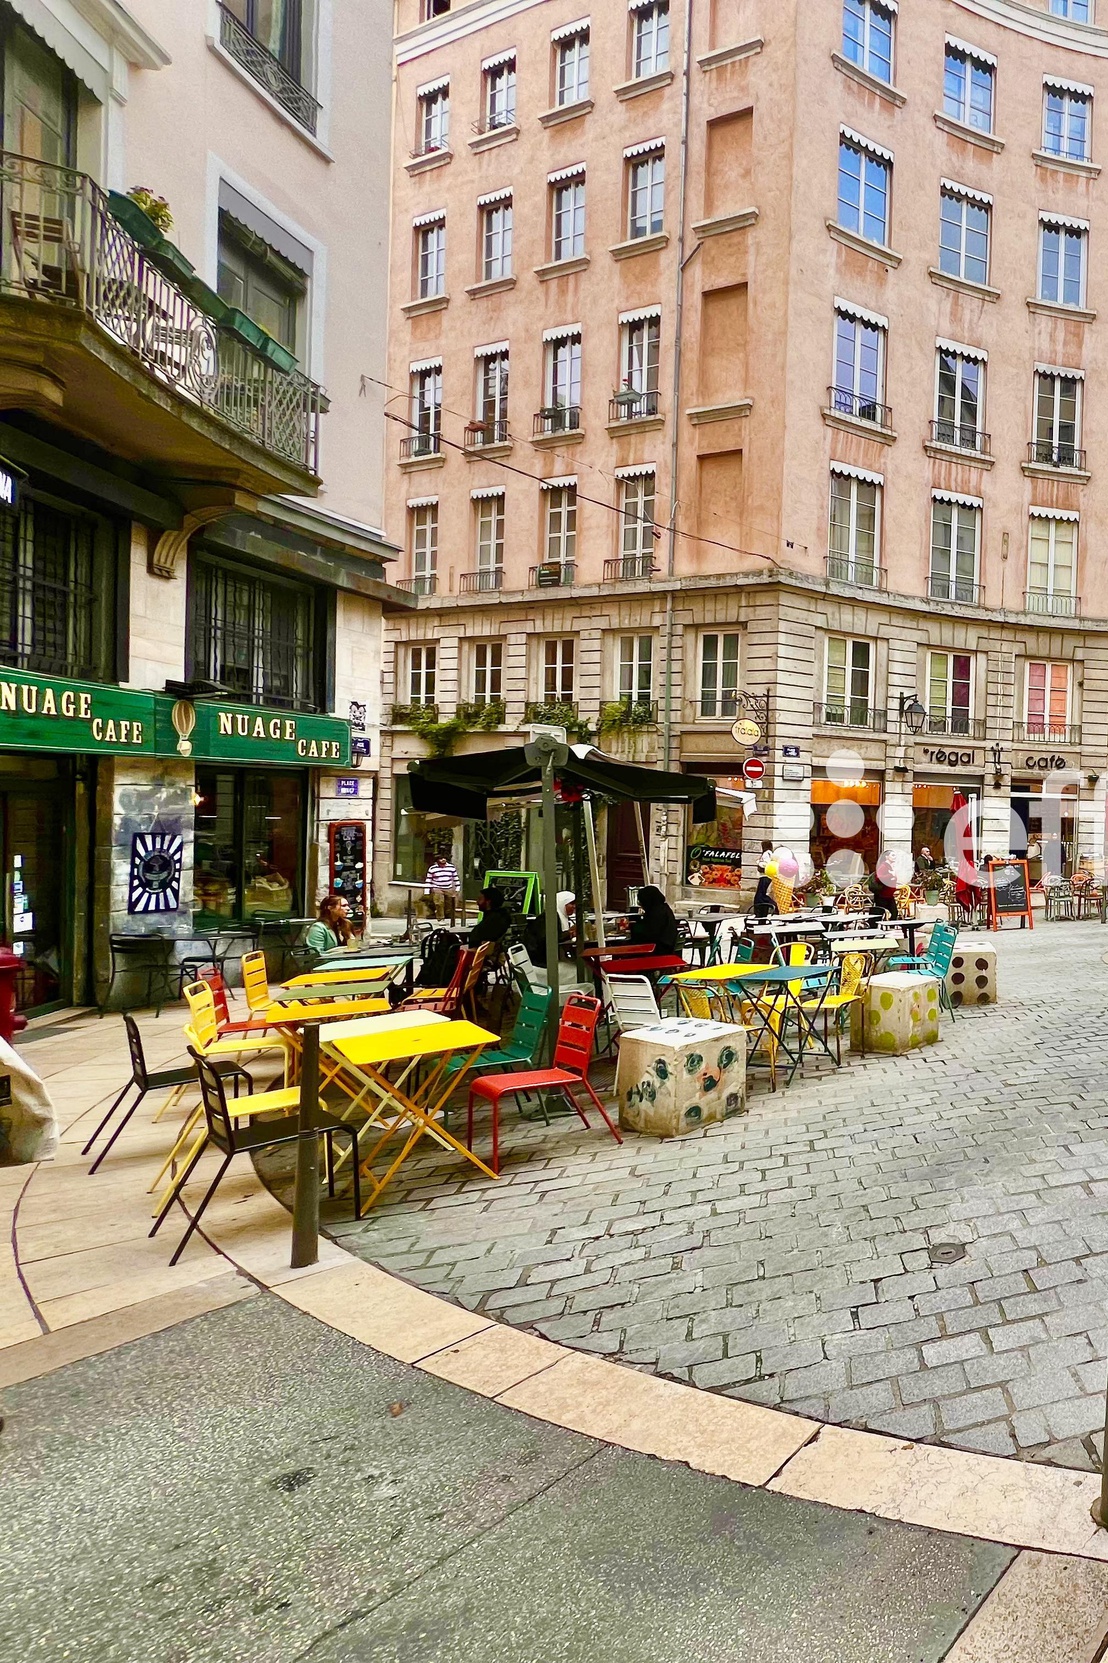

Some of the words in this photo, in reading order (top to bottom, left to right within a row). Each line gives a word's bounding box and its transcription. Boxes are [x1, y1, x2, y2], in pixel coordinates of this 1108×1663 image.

[0, 682, 92, 719] NUAGE
[92, 718, 142, 744] CAFE
[218, 712, 296, 740] NUAGE
[297, 739, 340, 759] CAFE
[929, 748, 975, 767] régal
[1025, 755, 1066, 770] café
